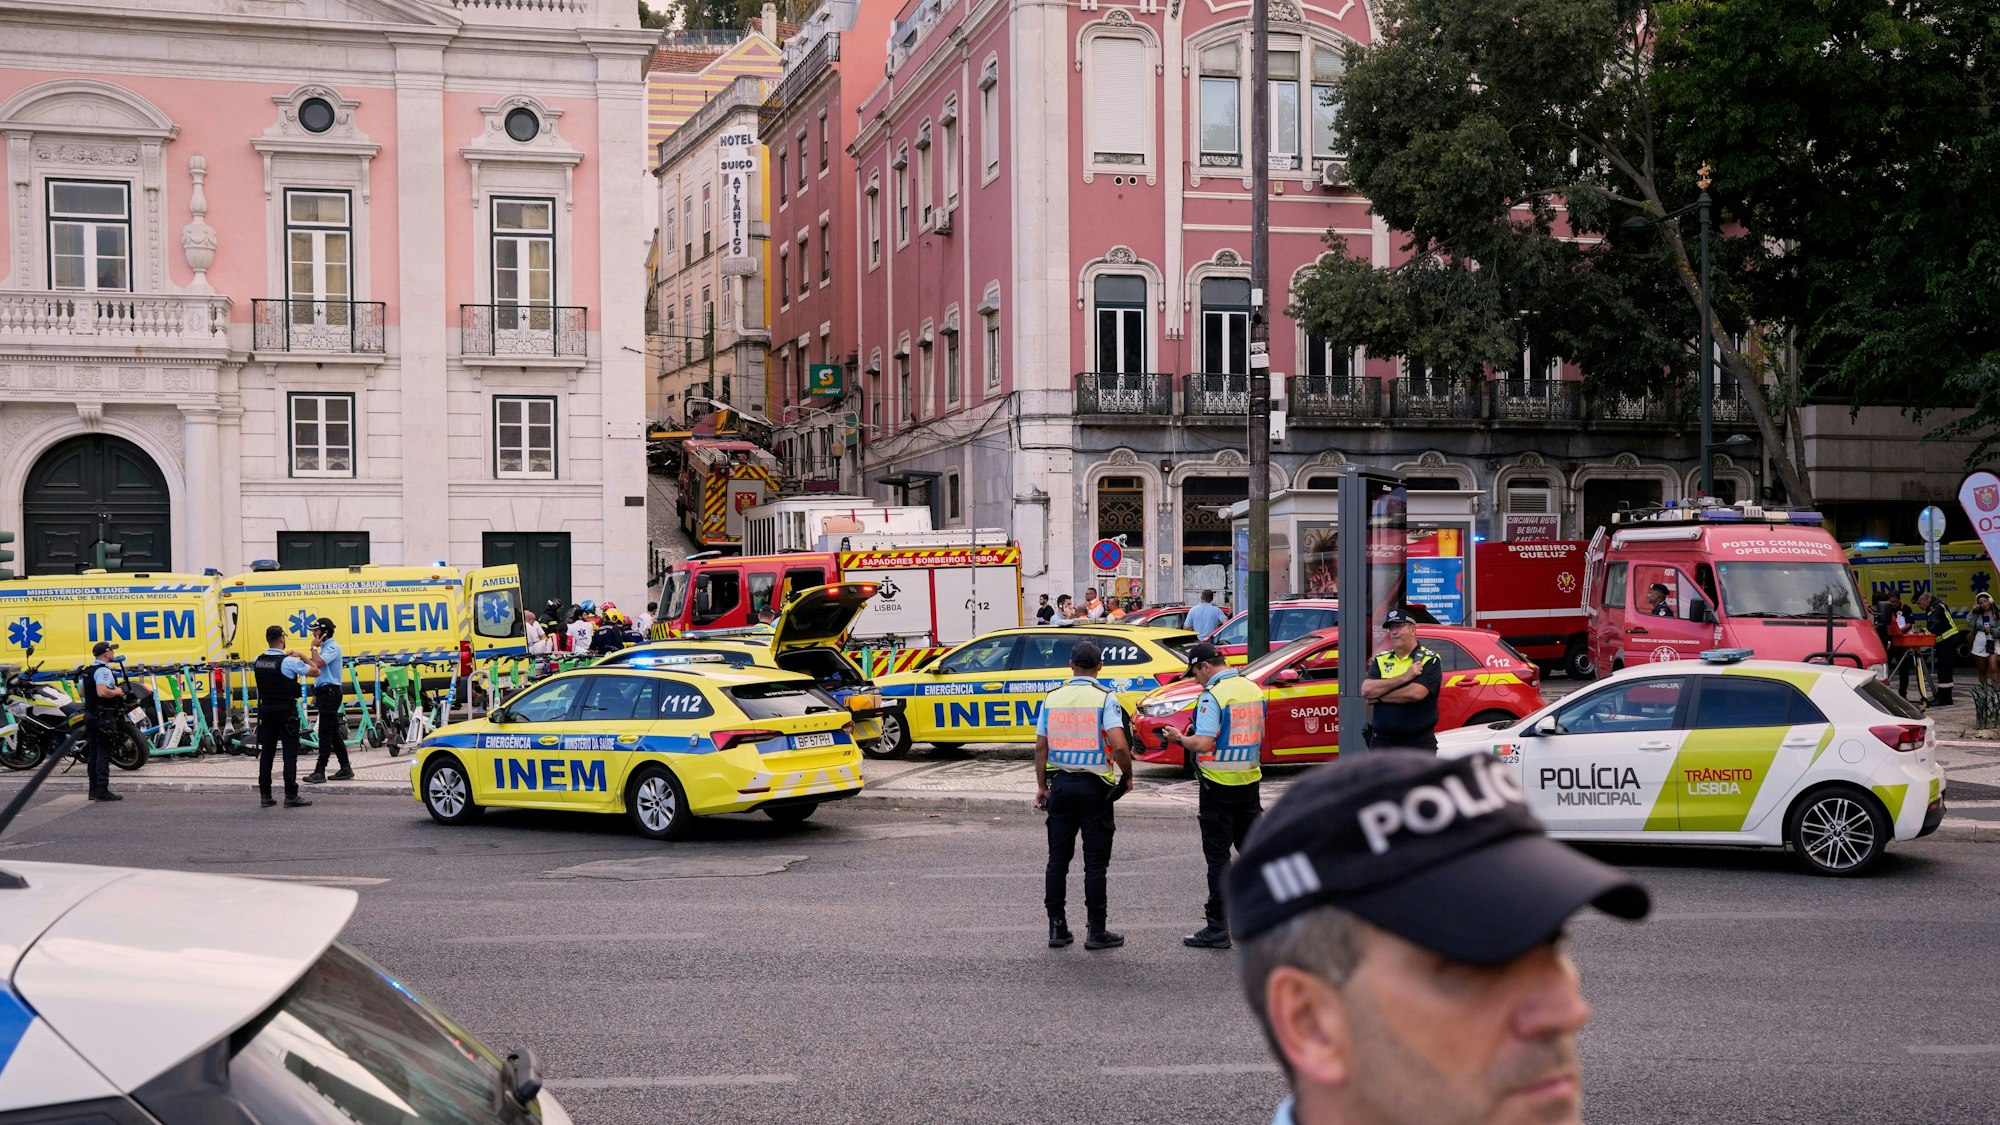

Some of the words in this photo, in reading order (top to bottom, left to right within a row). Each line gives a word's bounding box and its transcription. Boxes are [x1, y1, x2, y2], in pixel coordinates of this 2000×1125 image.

[720, 133, 754, 147] HOTEL
[1722, 540, 1766, 549] POSTO
[1769, 540, 1833, 550] COMANDO
[1735, 548, 1827, 556] OPERACIONAL
[862, 557, 914, 566] SAPADORES
[915, 556, 966, 564] BOMBEIROS
[968, 555, 999, 563] LSBOA
[27, 587, 81, 596] MINISTÉRIO
[300, 582, 347, 590] MINISTÉRIO
[1872, 580, 1930, 594] INEM
[874, 604, 902, 612] LISBOA
[350, 602, 449, 634] INEM
[88, 610, 195, 642] INEM
[1108, 646, 1138, 660] 112
[431, 663, 454, 673] 112
[1493, 658, 1511, 668] 112
[180, 680, 203, 692] 12
[924, 683, 974, 696] EMERGÊNCIA
[1009, 682, 1037, 693] MINISTÉRIO
[1037, 683, 1044, 693] DA
[671, 695, 703, 713] 112
[934, 701, 1044, 728] INEM
[1050, 710, 1096, 724] POLÍCIA
[485, 734, 532, 749] EMERGÊNCIA
[564, 735, 591, 750] MINISTÉRIO
[592, 738, 600, 750] DA
[600, 734, 615, 750] SAÚDE
[798, 736, 810, 747] BF
[810, 736, 818, 746] 57
[820, 734, 831, 744] PH
[1050, 735, 1097, 749] TRÂNSITO
[494, 758, 607, 792] INEM
[1540, 762, 1641, 790] POLÍCIA
[1684, 767, 1752, 782] TRÂNSITO
[1688, 781, 1741, 795] LISBOA
[1557, 792, 1642, 806] MUNICIPAL
